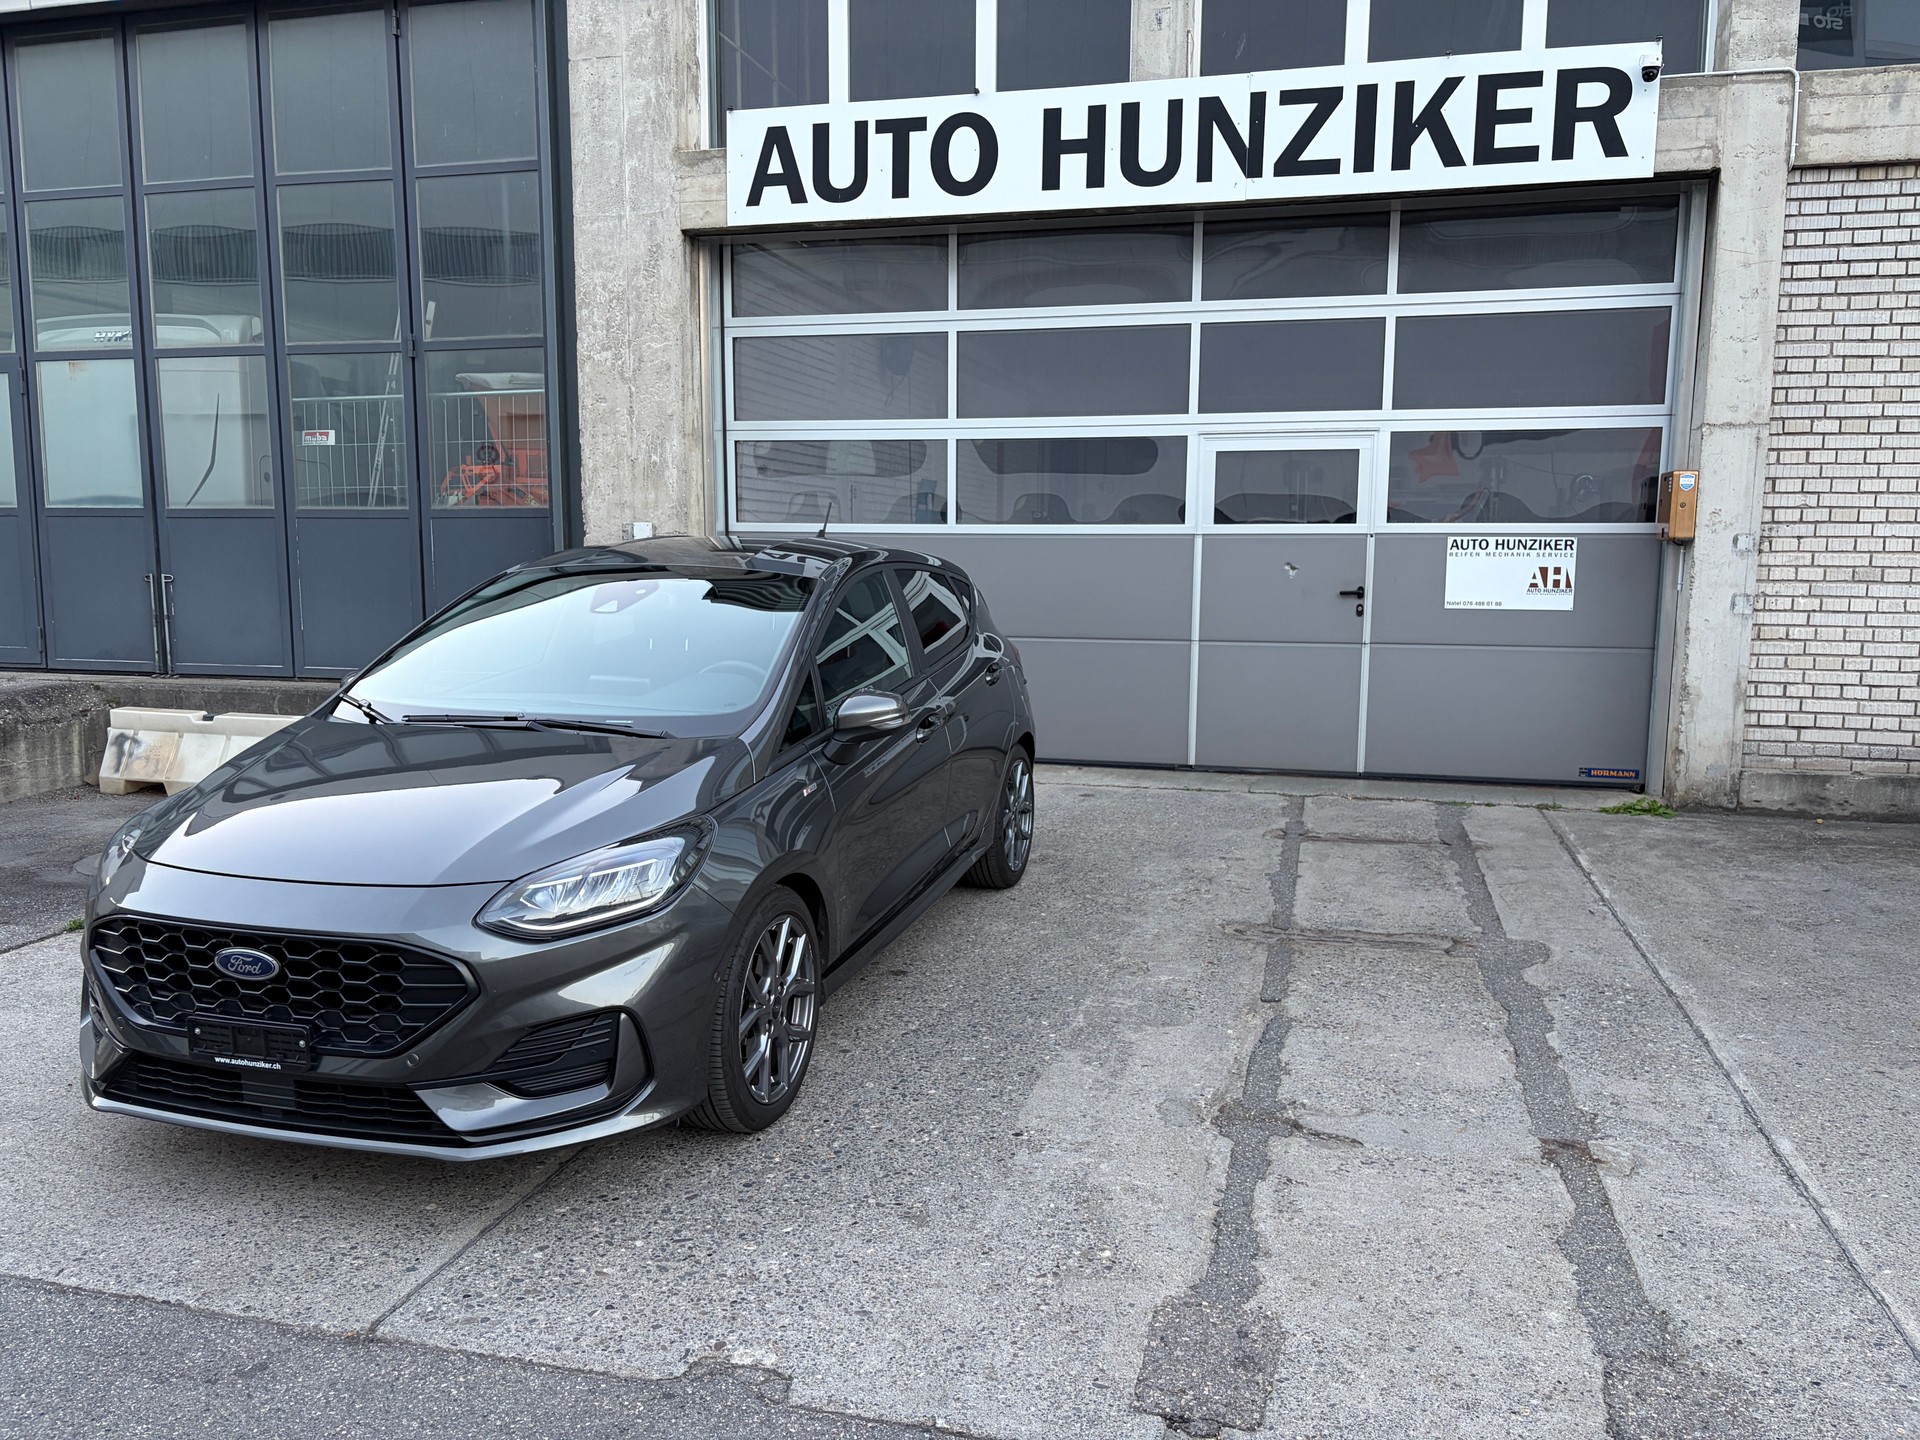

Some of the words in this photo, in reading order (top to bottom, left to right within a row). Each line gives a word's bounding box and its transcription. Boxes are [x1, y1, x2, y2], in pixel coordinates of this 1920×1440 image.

[746, 112, 999, 207] AUTO
[1041, 66, 1634, 191] HUNZIKER
[94, 331, 132, 342] HYM
[1450, 539, 1489, 551] AUTO
[1495, 539, 1575, 551] HUNZIKER
[227, 955, 262, 975] Ford
[214, 1056, 281, 1070] www.autohunziker.ch
